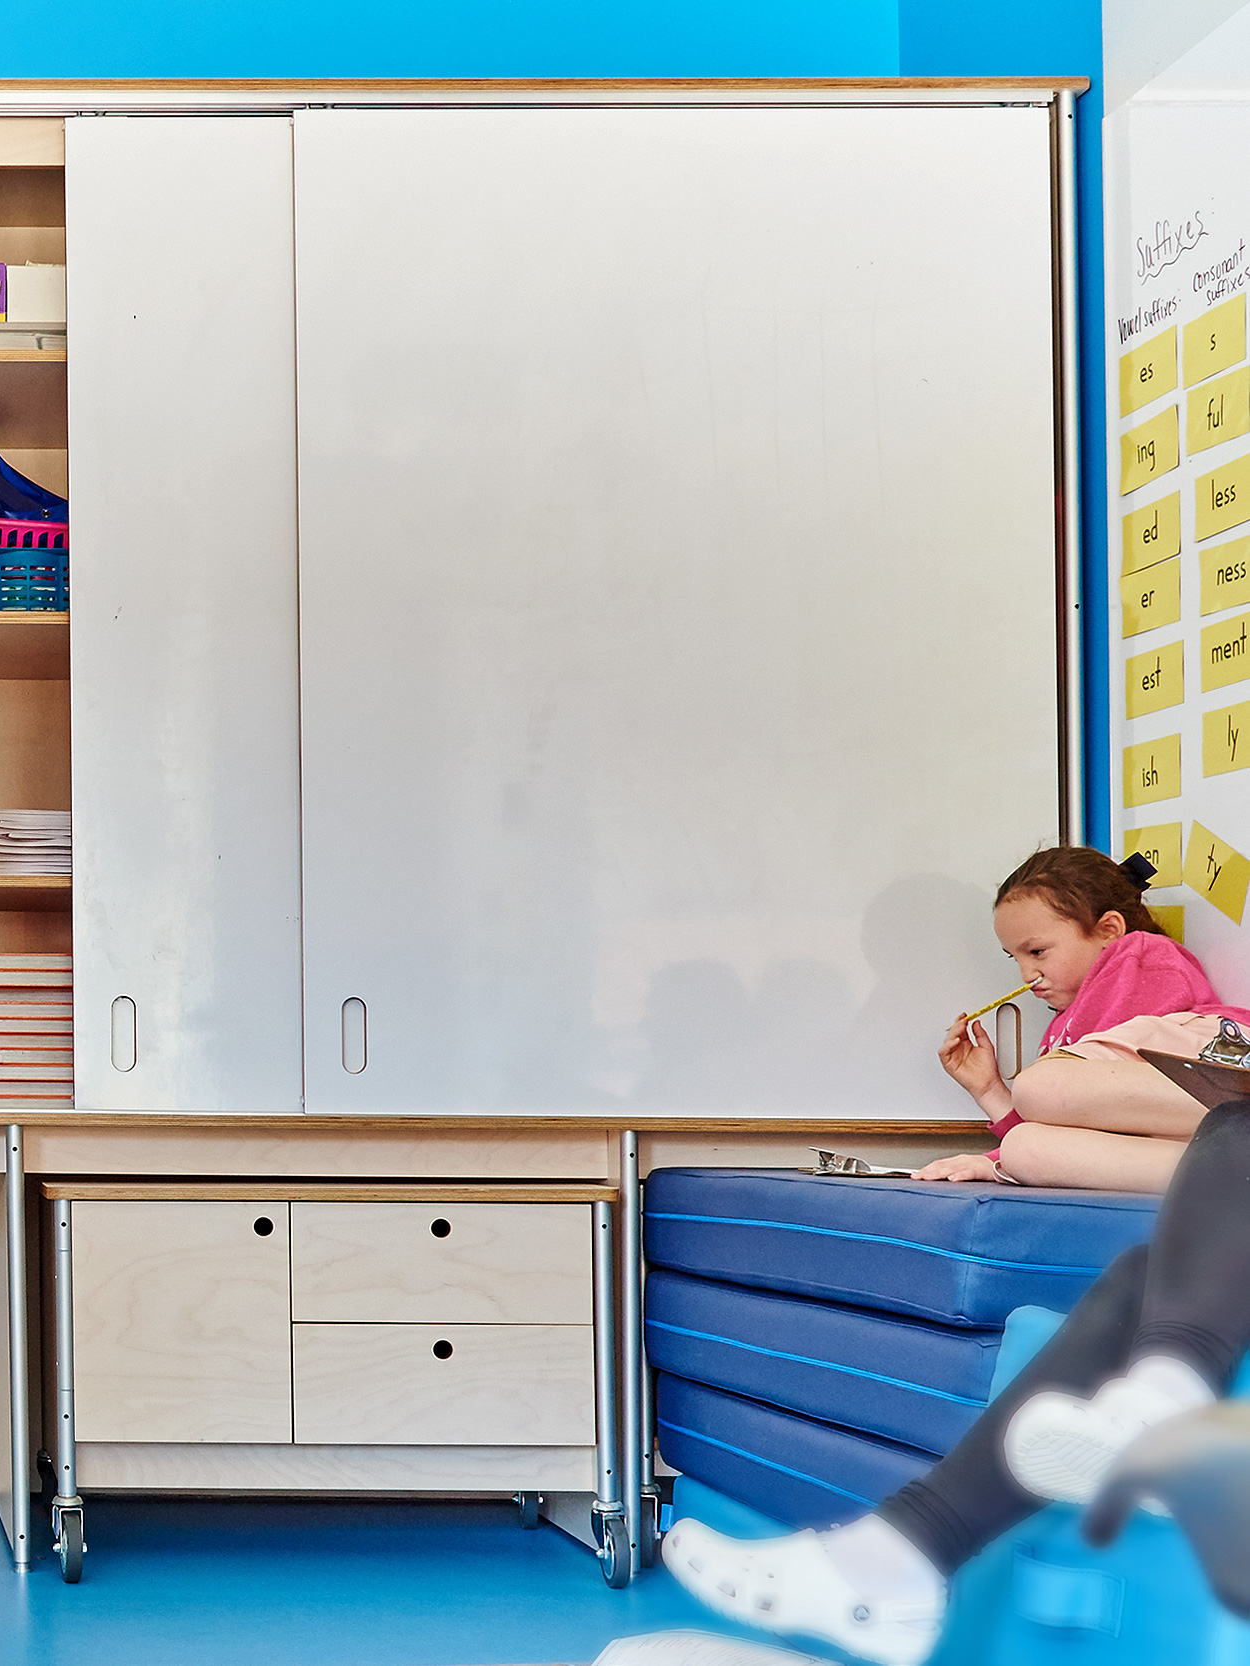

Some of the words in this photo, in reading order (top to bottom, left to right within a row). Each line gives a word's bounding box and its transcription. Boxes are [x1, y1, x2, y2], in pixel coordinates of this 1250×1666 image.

[1210, 333, 1217, 351] s
[1139, 363, 1154, 383] es
[1207, 393, 1224, 431] ful
[1137, 440, 1156, 472] ing
[1211, 479, 1236, 510] less
[1143, 510, 1158, 544] ed
[1216, 561, 1247, 586] ness
[1141, 590, 1155, 608] er
[1211, 622, 1247, 664] ment
[1142, 656, 1161, 691] est
[1228, 715, 1239, 761] ly
[1142, 755, 1159, 788] ish
[1144, 849, 1159, 864] en
[1207, 844, 1222, 891] ty
